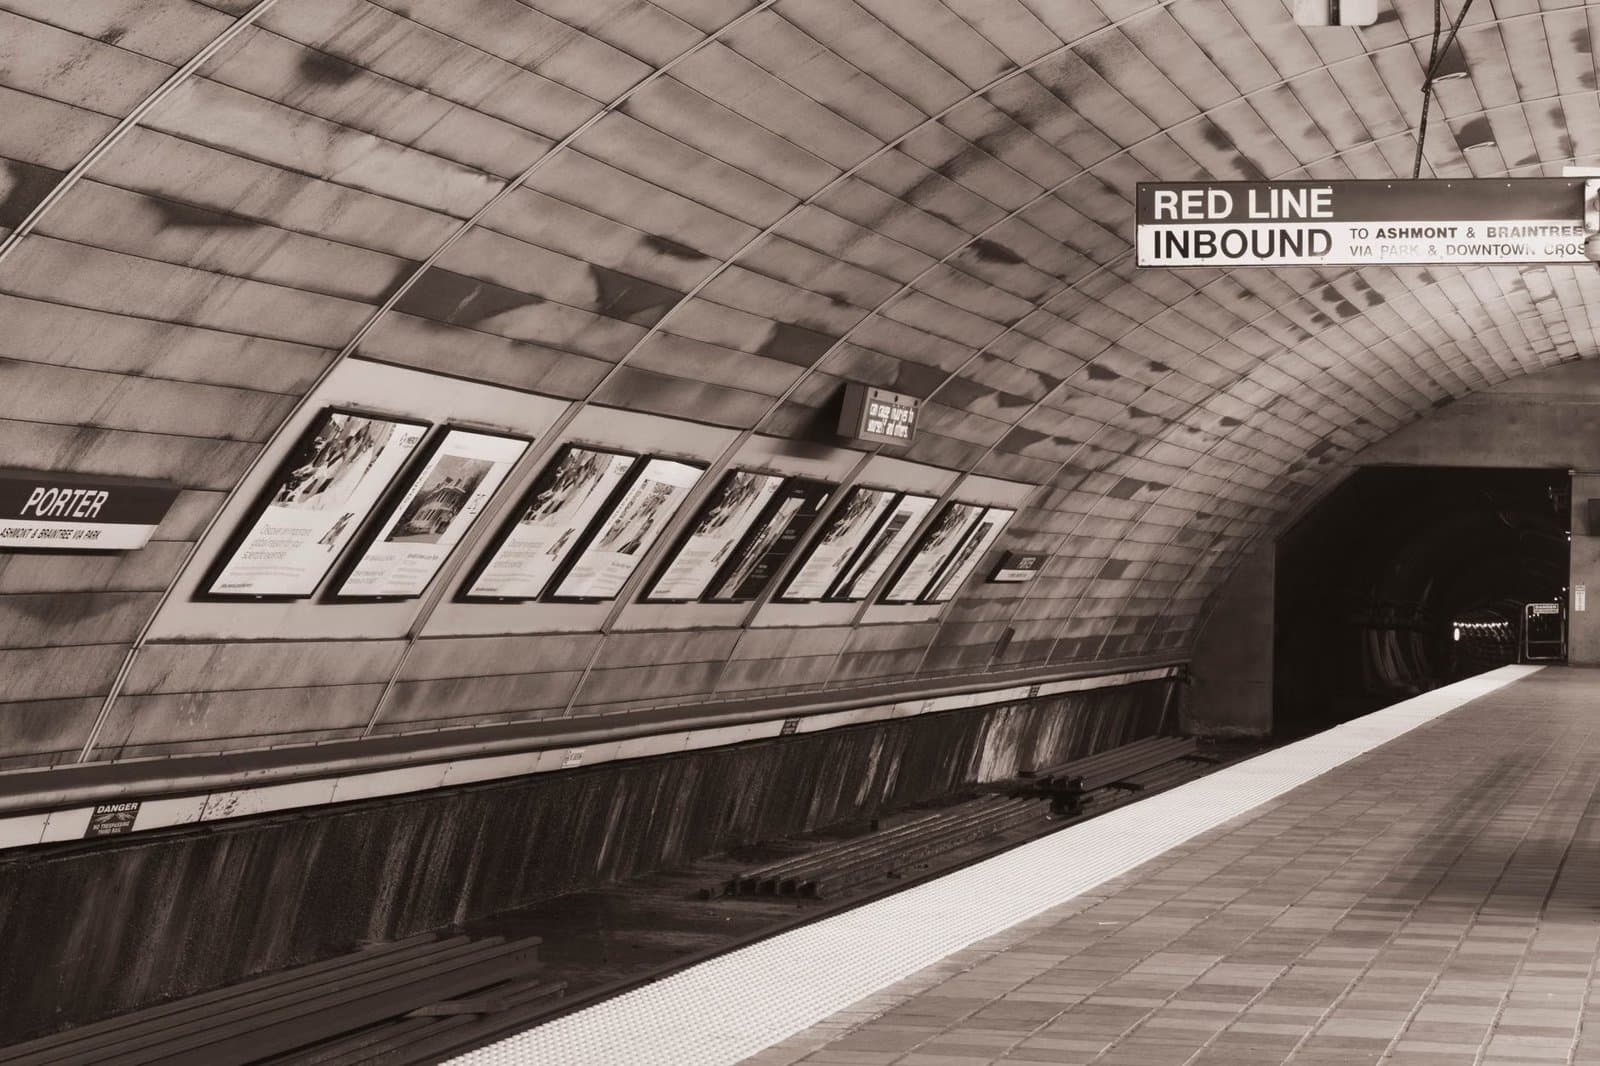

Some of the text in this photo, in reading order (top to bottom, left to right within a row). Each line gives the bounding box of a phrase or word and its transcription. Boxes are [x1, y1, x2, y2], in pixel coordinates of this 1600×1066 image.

[1154, 188, 1334, 220] RED LINE
[1349, 226, 1584, 240] TO ASHMONT & BRAINTREE
[1154, 228, 1333, 259] INBOUND
[1349, 244, 1373, 257] VIA
[1381, 244, 1418, 256] PARK
[1427, 244, 1437, 256] &
[20, 486, 110, 519] PORTER
[0, 527, 32, 539] ASHMONT
[38, 528, 74, 540] BRAINTREE
[97, 802, 138, 814] DANGER
